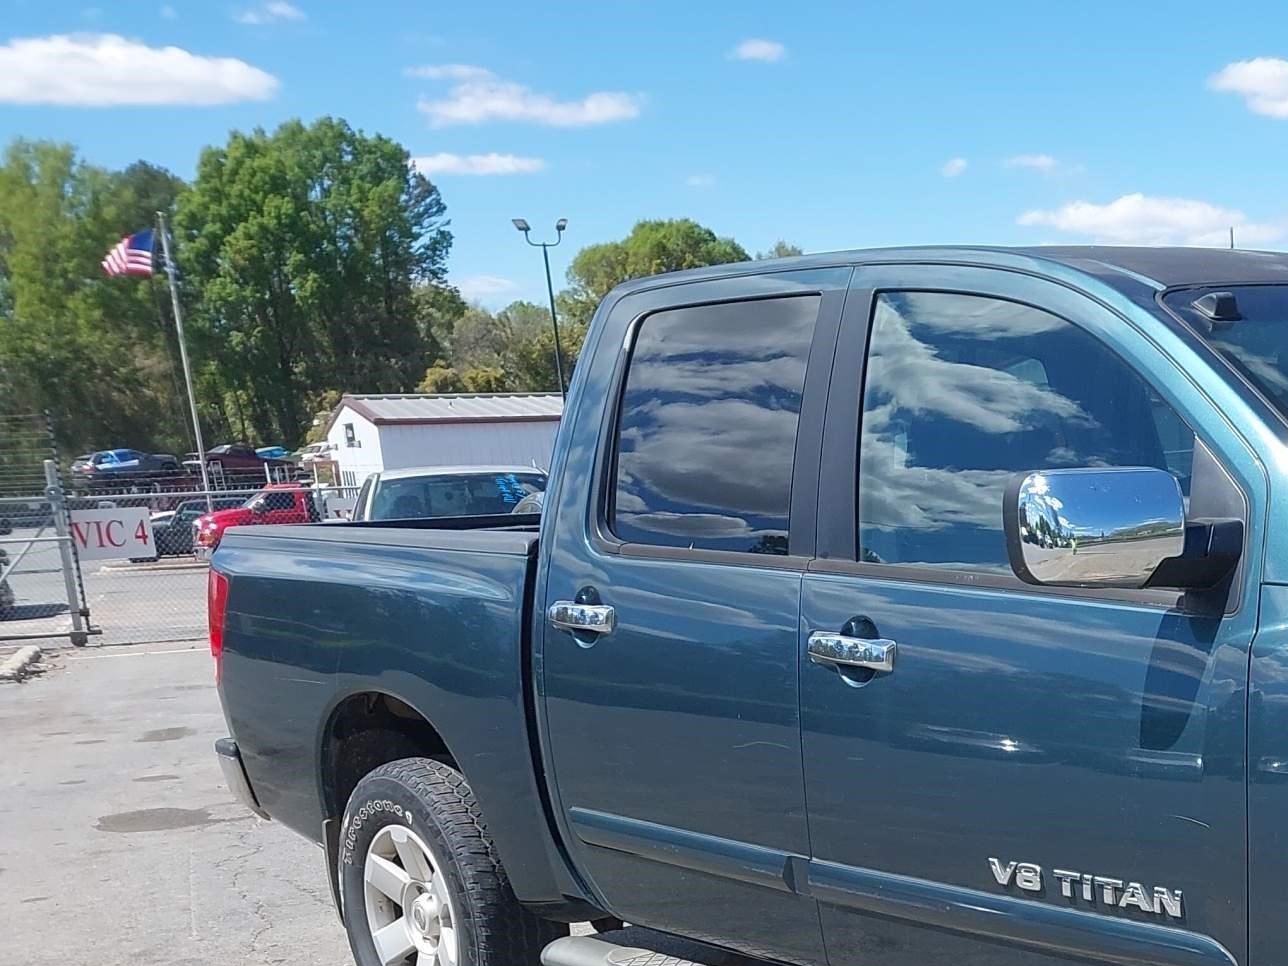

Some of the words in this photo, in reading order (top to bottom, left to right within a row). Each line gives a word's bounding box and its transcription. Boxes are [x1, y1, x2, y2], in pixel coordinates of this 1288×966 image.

[71, 519, 127, 549] VIC
[134, 519, 149, 545] 4
[988, 857, 1043, 892] V8
[1053, 869, 1184, 919] TITAN
